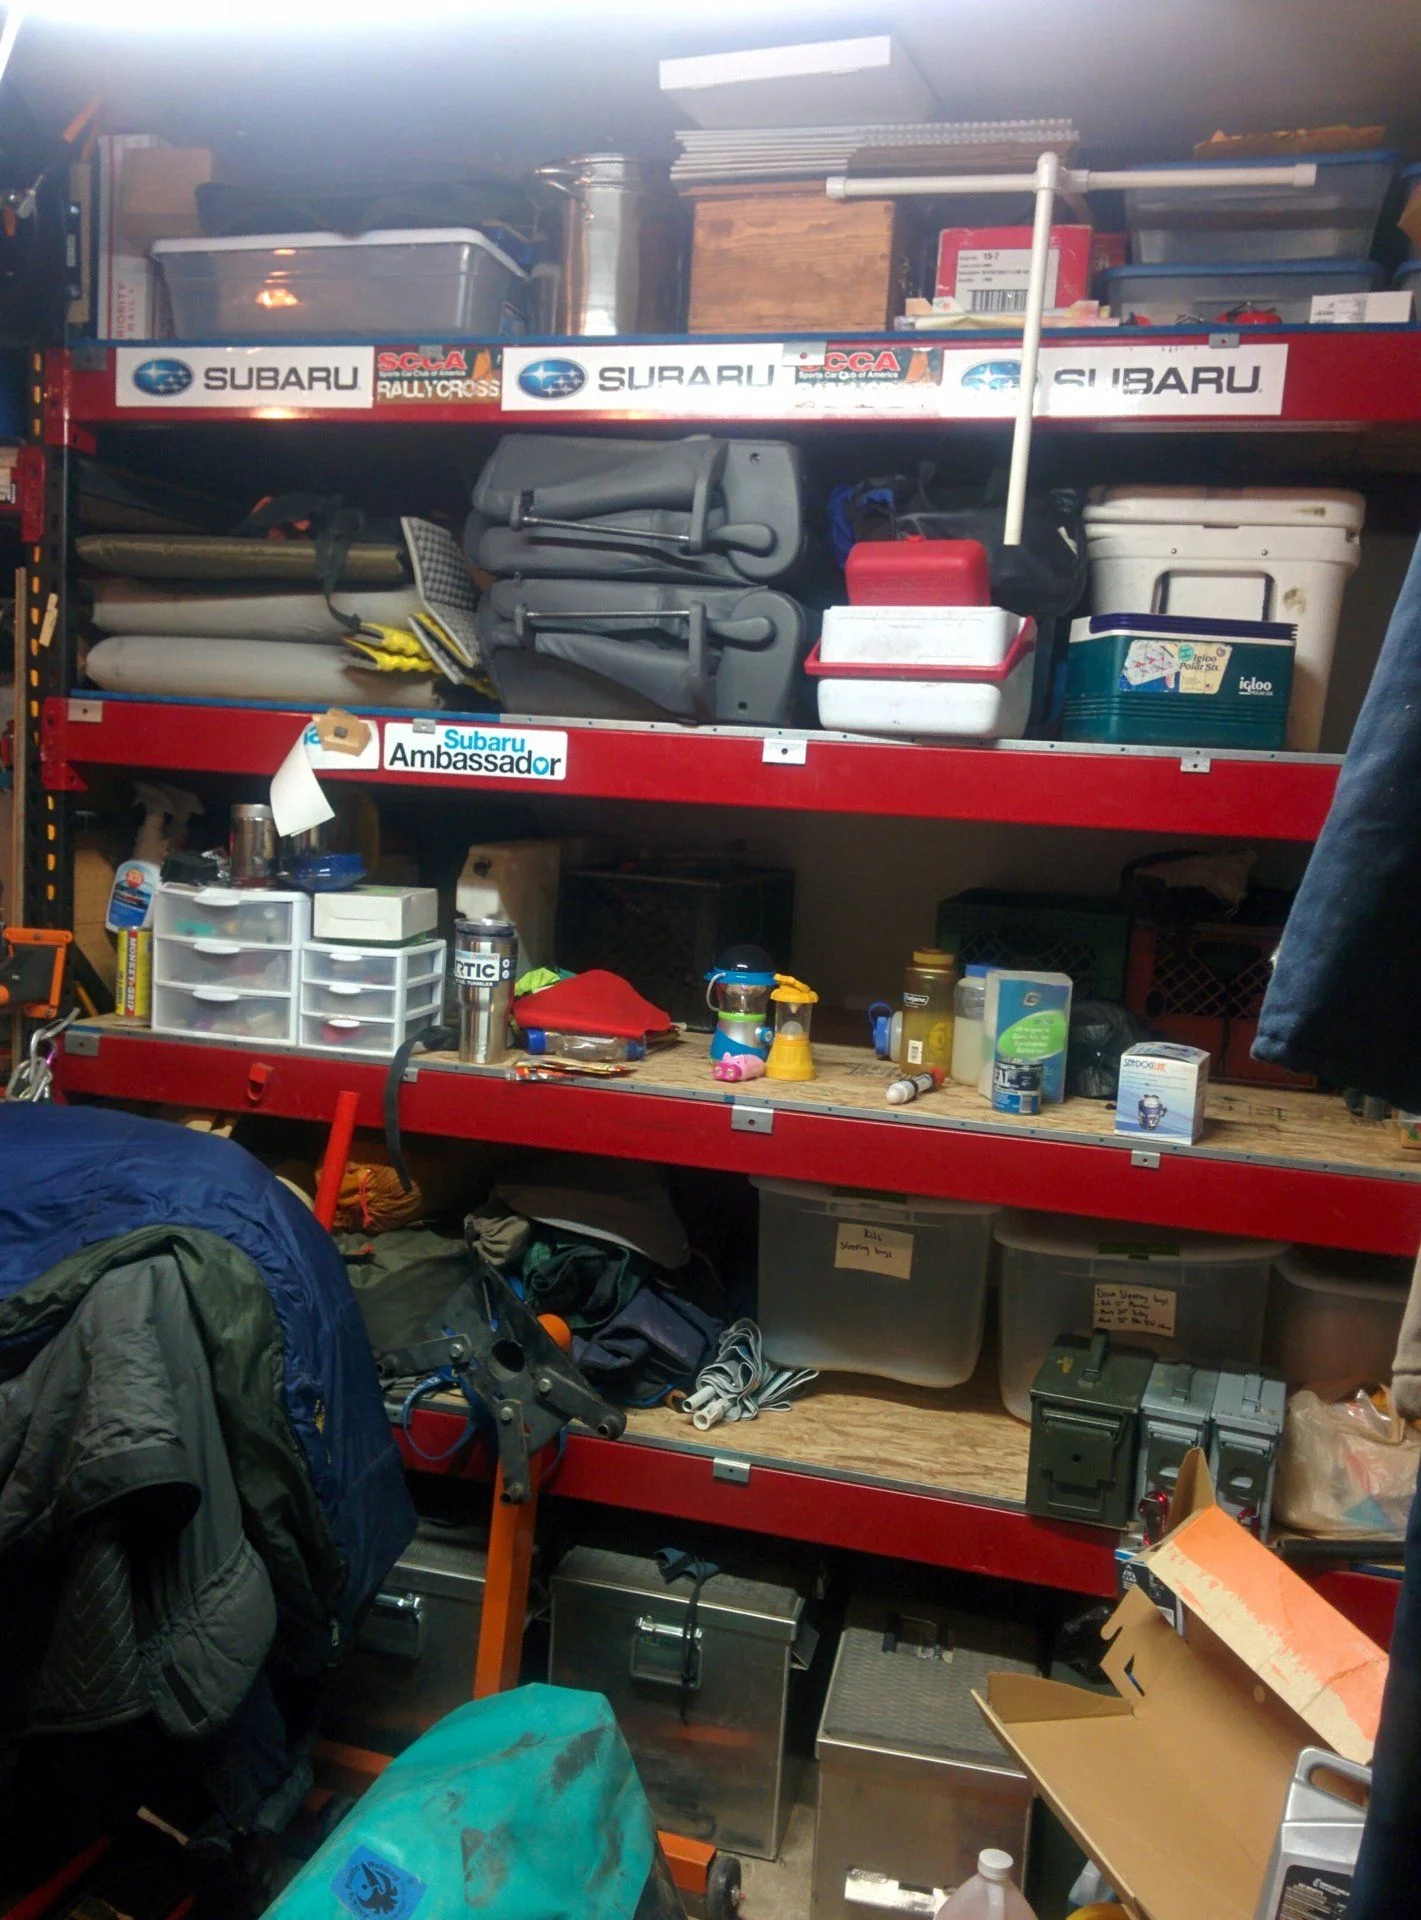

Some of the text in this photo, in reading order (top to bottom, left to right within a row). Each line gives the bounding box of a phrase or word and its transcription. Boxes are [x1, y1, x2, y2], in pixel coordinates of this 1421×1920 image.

[799, 351, 901, 372] CCA
[204, 366, 359, 391] SUBARU
[377, 380, 500, 399] RALLYCROSS
[1180, 662, 1203, 671] Polar
[1193, 653, 1217, 665] Igloo
[1239, 677, 1272, 692] igloo
[444, 729, 525, 752] Subaru
[389, 742, 561, 776] Ambassador
